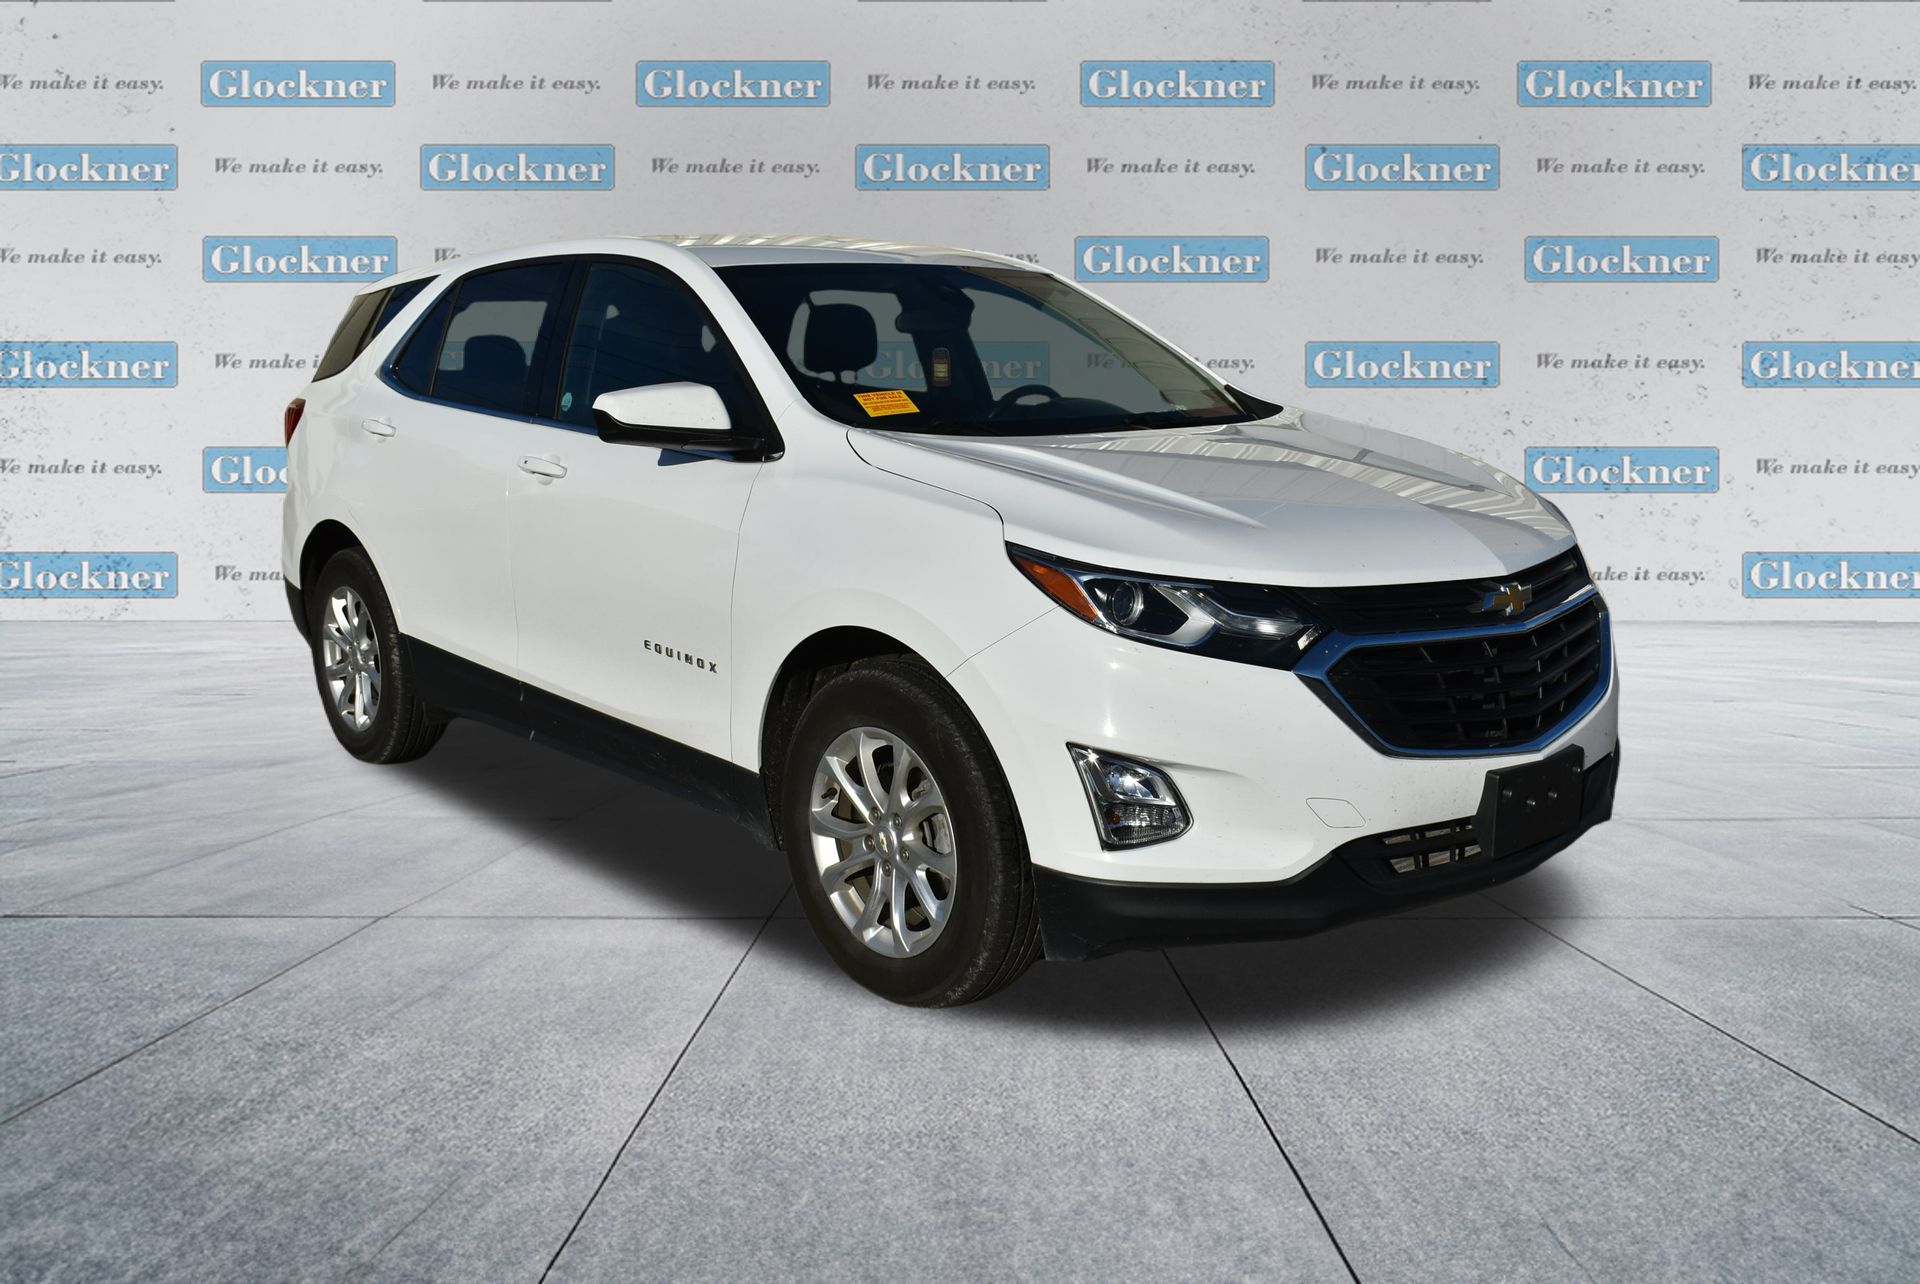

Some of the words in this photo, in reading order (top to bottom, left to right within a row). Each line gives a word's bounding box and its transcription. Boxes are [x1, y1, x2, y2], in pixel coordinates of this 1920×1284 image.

[29, 74, 87, 90] make
[92, 75, 109, 90] it
[115, 79, 164, 94] easy.
[208, 69, 388, 98] Glockner
[432, 74, 460, 90] We
[466, 74, 524, 90] make
[529, 75, 546, 90] it
[552, 79, 601, 94] easy.
[643, 69, 823, 98] Glockner
[867, 74, 895, 90] We
[901, 74, 959, 90] make
[964, 75, 981, 90] it
[987, 79, 1036, 94] easy.
[1087, 69, 1267, 98] Glockner
[1311, 74, 1339, 90] We
[1345, 74, 1403, 90] make
[1408, 75, 1425, 90] it
[1431, 79, 1480, 94] easy.
[1524, 69, 1704, 98] Glockner
[1748, 74, 1776, 90] We
[1782, 74, 1840, 90] make
[1845, 75, 1862, 90] it
[1868, 79, 1917, 94] easy.
[214, 158, 242, 174] We
[248, 158, 306, 174] make
[311, 159, 328, 174] it
[334, 163, 383, 178] easy.
[427, 153, 607, 182] Glockner
[651, 158, 679, 174] We
[685, 158, 743, 174] make
[748, 159, 765, 174] it
[771, 163, 820, 178] easy.
[862, 153, 1042, 182] Glockner
[1086, 158, 1114, 174] We
[1120, 158, 1178, 174] make
[1183, 159, 1200, 174] it
[1206, 163, 1255, 178] easy.
[1312, 153, 1492, 182] Glockner
[1536, 158, 1564, 174] We
[1570, 158, 1628, 174] make
[1633, 159, 1650, 174] it
[1656, 163, 1705, 178] easy.
[27, 248, 85, 264] make
[90, 249, 107, 264] it
[113, 253, 162, 268] easy.
[210, 244, 390, 273] Glockner
[1082, 244, 1262, 273] Glockner
[1315, 248, 1343, 264] We
[1349, 248, 1407, 264] make
[1412, 249, 1429, 264] it
[1435, 253, 1484, 268] easy.
[1532, 244, 1712, 273] Glockner
[1756, 248, 1784, 264] We
[1790, 248, 1848, 264] make
[1853, 249, 1870, 264] it
[214, 353, 242, 369] We
[248, 353, 306, 369] make
[312, 354, 321, 369] i
[1206, 358, 1255, 373] easy.
[1312, 350, 1492, 379] Glockner
[1536, 353, 1564, 369] We
[1570, 353, 1628, 369] make
[1633, 354, 1650, 369] it
[1656, 358, 1705, 373] easy.
[27, 458, 85, 474] make
[90, 459, 107, 474] it
[113, 463, 162, 478] easy.
[1532, 455, 1712, 484] Glockner
[1756, 458, 1784, 474] We
[1790, 458, 1848, 474] make
[1853, 459, 1870, 474] it
[214, 565, 242, 581] We
[248, 570, 283, 581] ma
[1592, 565, 1629, 581] ake
[1633, 566, 1650, 581] it
[1656, 570, 1705, 585] easy.
[643, 639, 718, 674] EQUINOX
